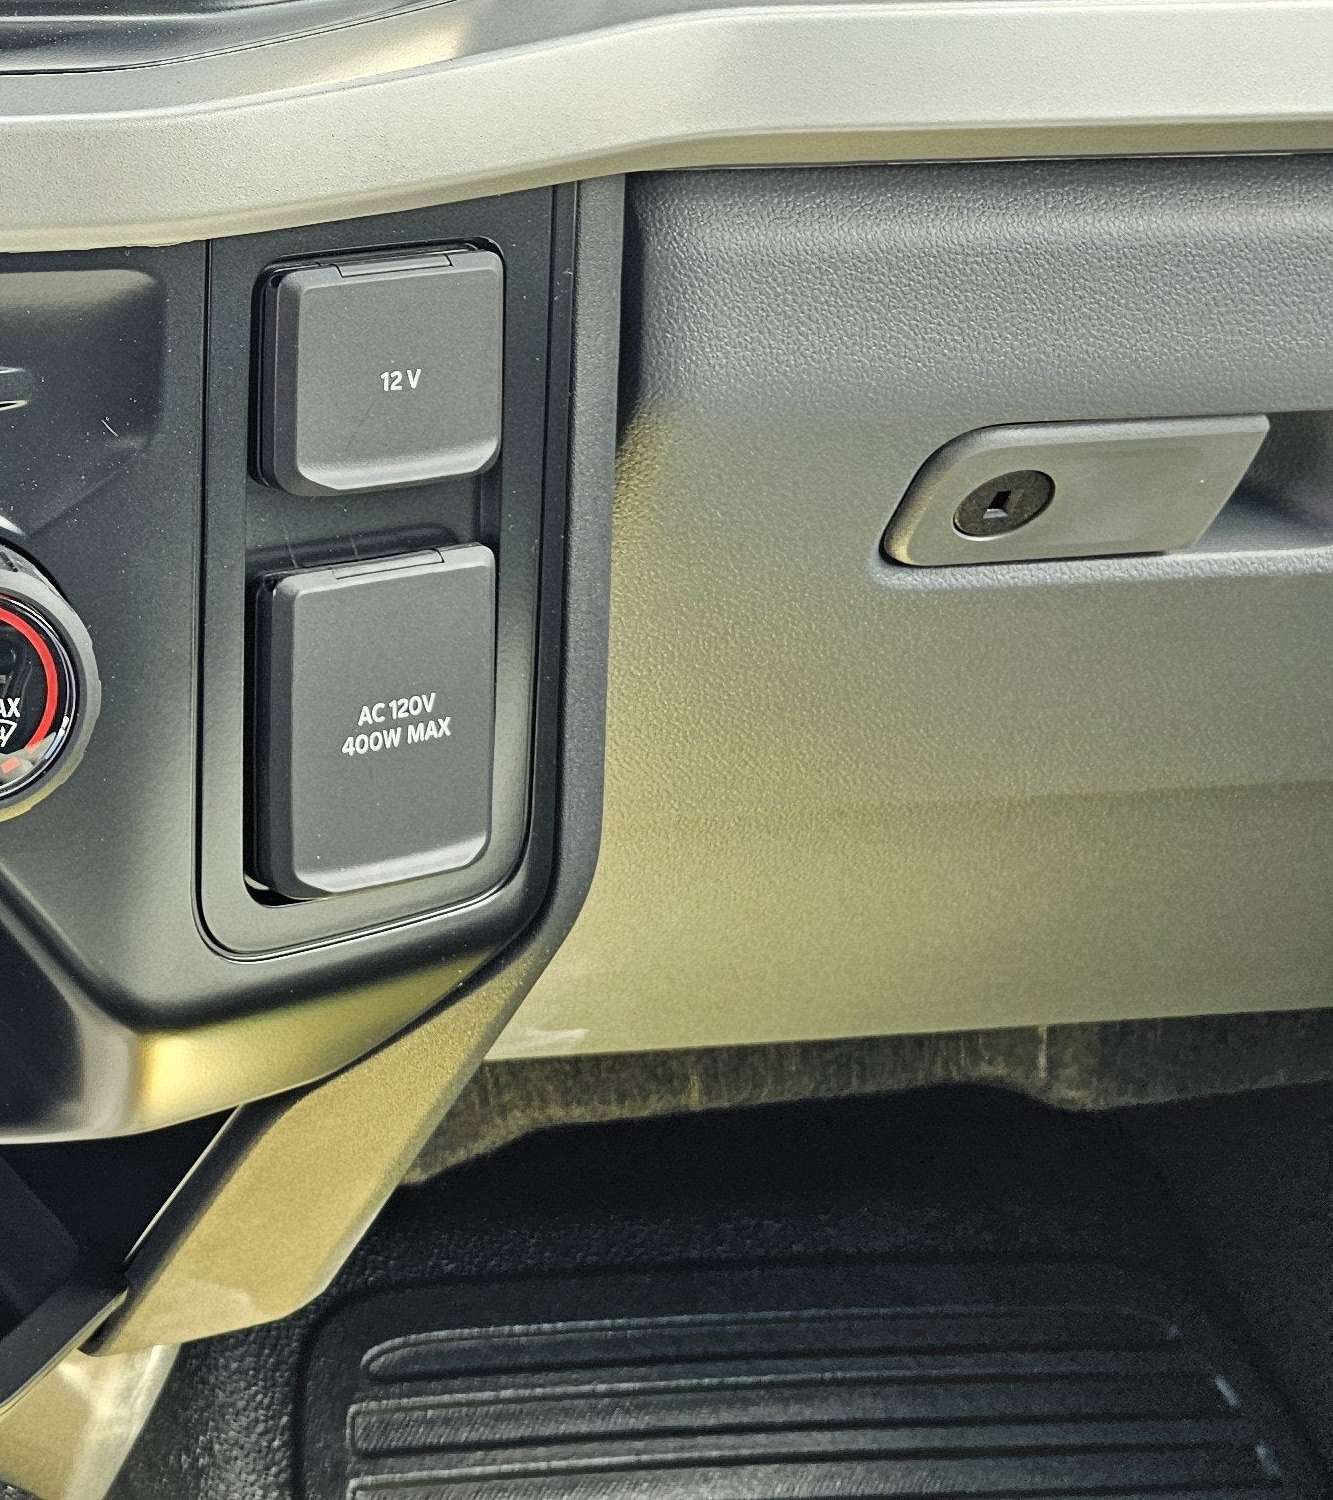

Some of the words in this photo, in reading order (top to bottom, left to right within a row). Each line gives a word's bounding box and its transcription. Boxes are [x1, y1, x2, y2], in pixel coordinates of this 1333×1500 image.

[379, 370, 404, 392] 12
[406, 368, 423, 390] V
[357, 701, 386, 727] AC
[388, 692, 437, 721] 120V
[341, 727, 401, 758] 400W
[406, 715, 452, 744] MAX
